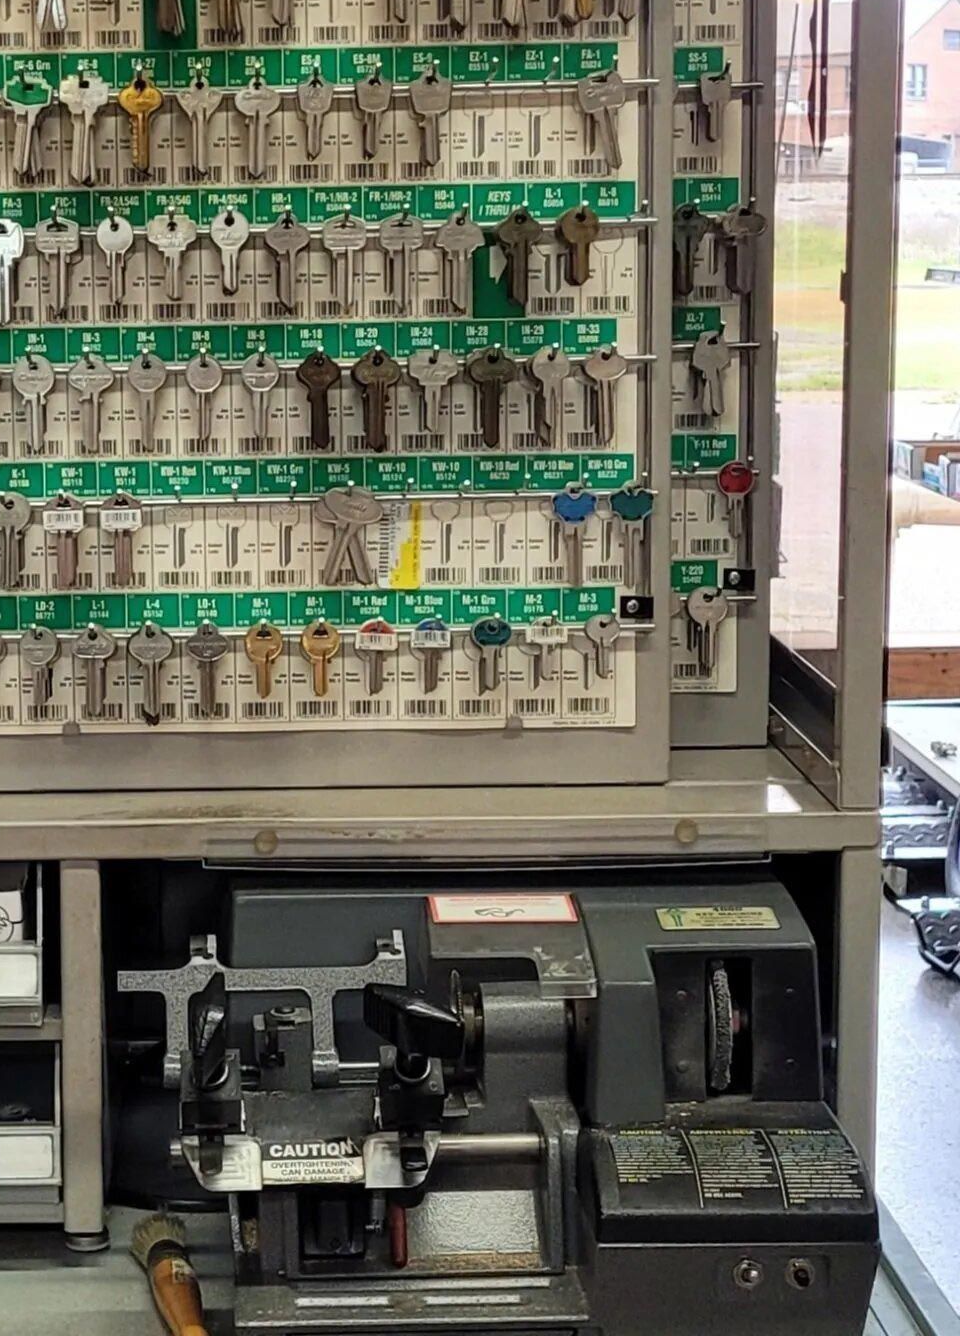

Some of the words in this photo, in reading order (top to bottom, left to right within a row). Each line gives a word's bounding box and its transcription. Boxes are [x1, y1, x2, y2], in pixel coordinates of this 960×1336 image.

[488, 191, 511, 201] KEYS
[486, 205, 509, 216] THRU
[62, 467, 83, 478] KW-1
[115, 467, 136, 477] KW-1
[253, 597, 269, 608] M-1
[308, 597, 323, 606] M-1
[353, 595, 369, 605] M-1
[463, 594, 478, 604] M-1
[525, 594, 542, 604] M-2
[580, 593, 596, 603] M-3
[147, 599, 160, 609] L-4
[269, 1141, 353, 1157] CAUTION
[281, 1168, 301, 1176] CAN
